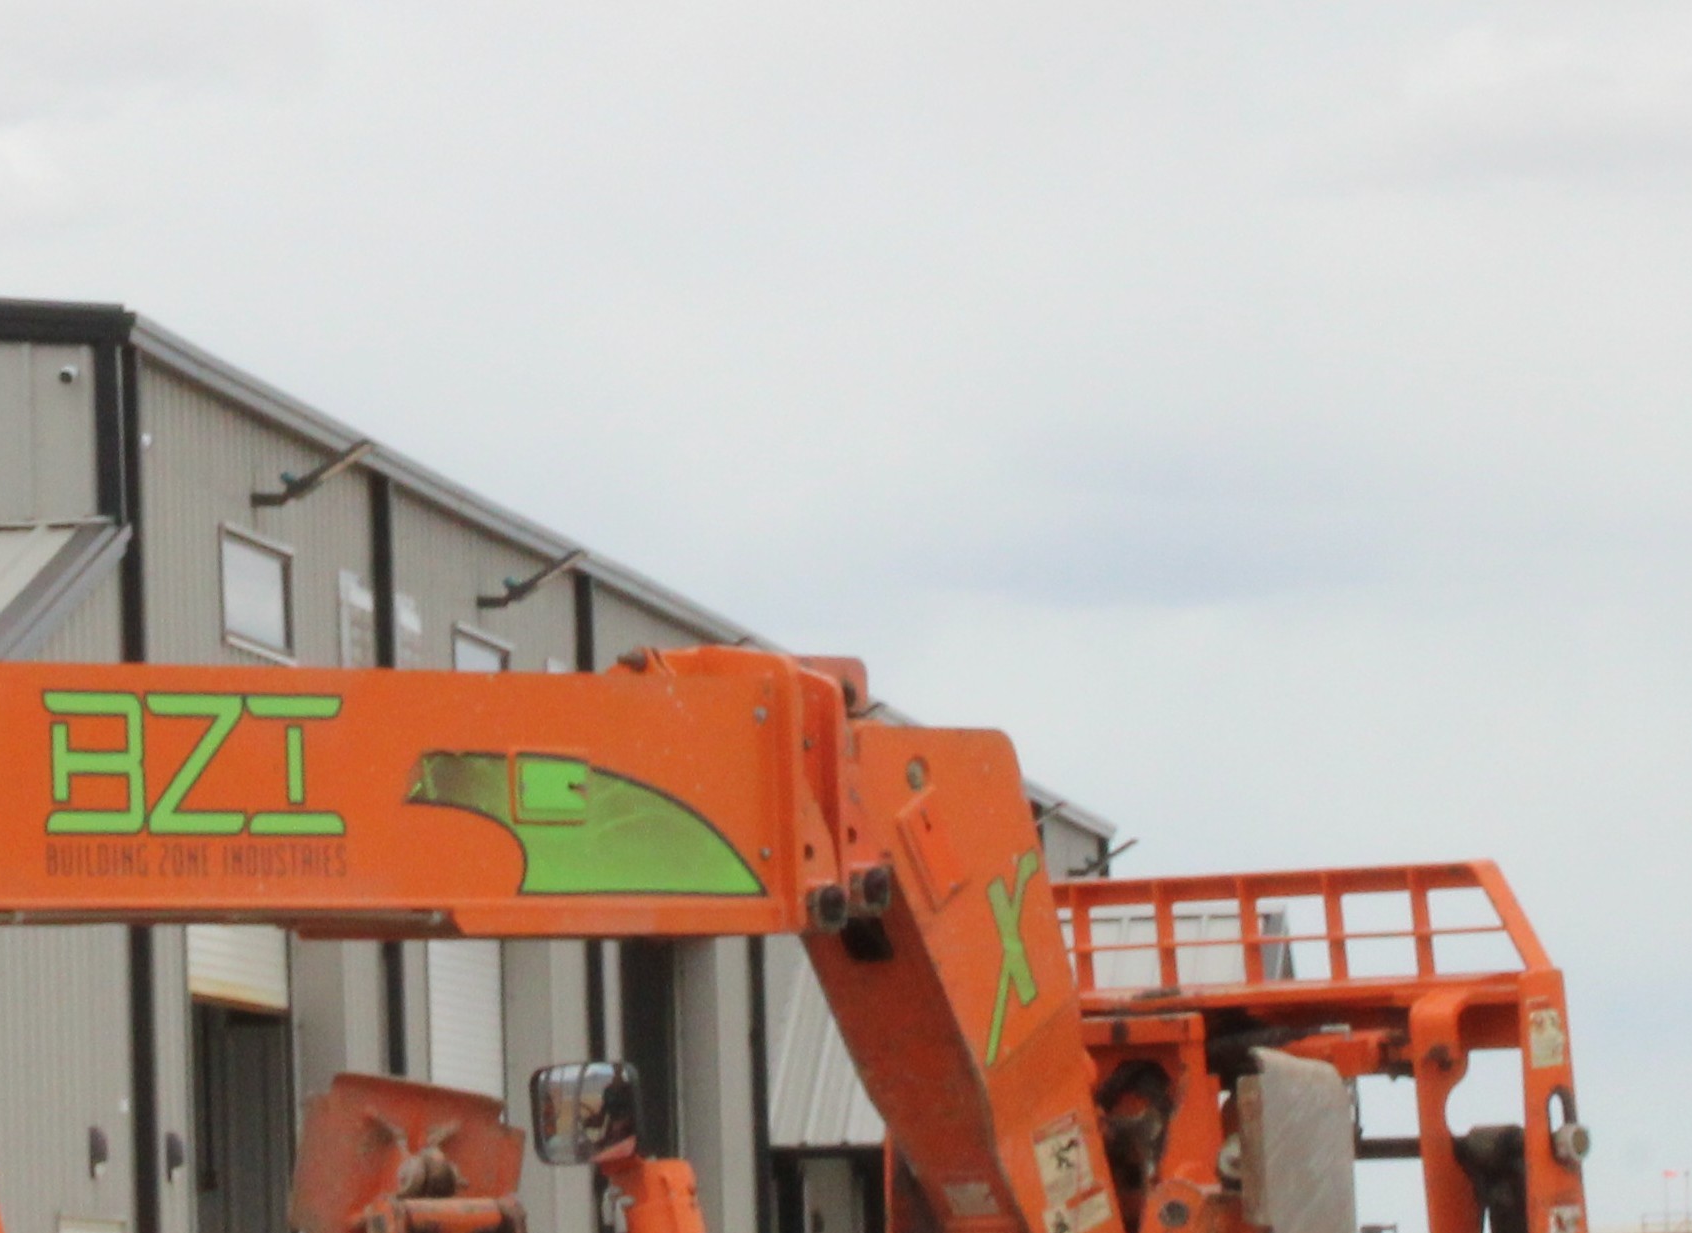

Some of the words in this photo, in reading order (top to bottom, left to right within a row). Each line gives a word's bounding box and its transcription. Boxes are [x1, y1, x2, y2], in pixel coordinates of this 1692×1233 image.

[43, 688, 346, 836] BZI
[45, 843, 148, 878] BUILDING
[158, 843, 210, 878] ZONE
[221, 843, 348, 878] INDUSTRIES
